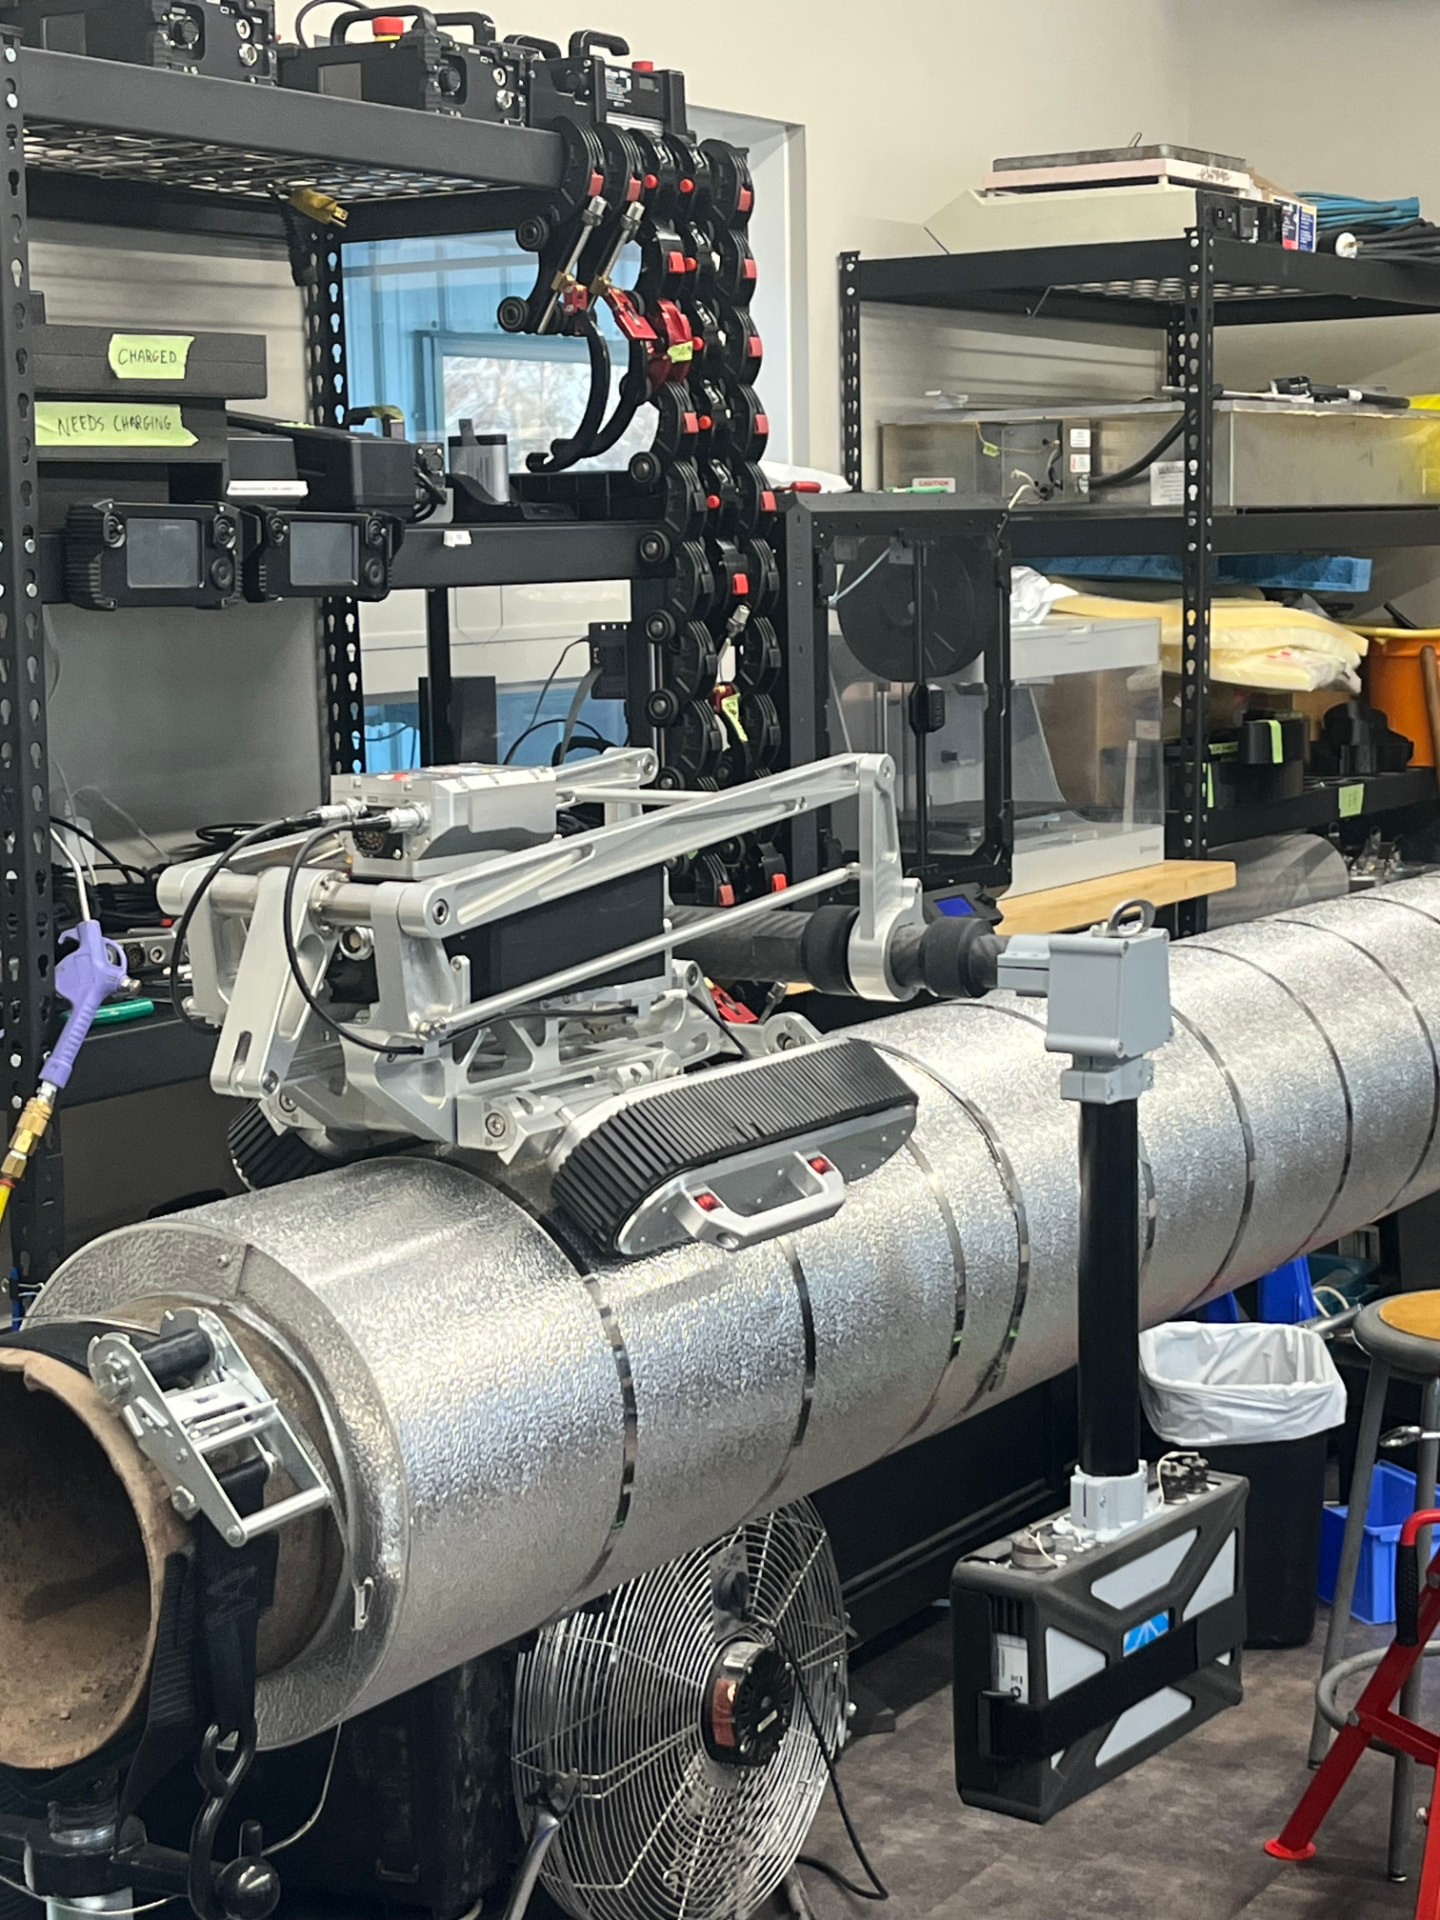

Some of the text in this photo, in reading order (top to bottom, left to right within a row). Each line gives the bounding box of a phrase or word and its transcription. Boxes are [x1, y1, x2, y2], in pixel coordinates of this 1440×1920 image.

[117, 348, 177, 365] CHARGED
[57, 414, 172, 437] NEEDS CHARGING
